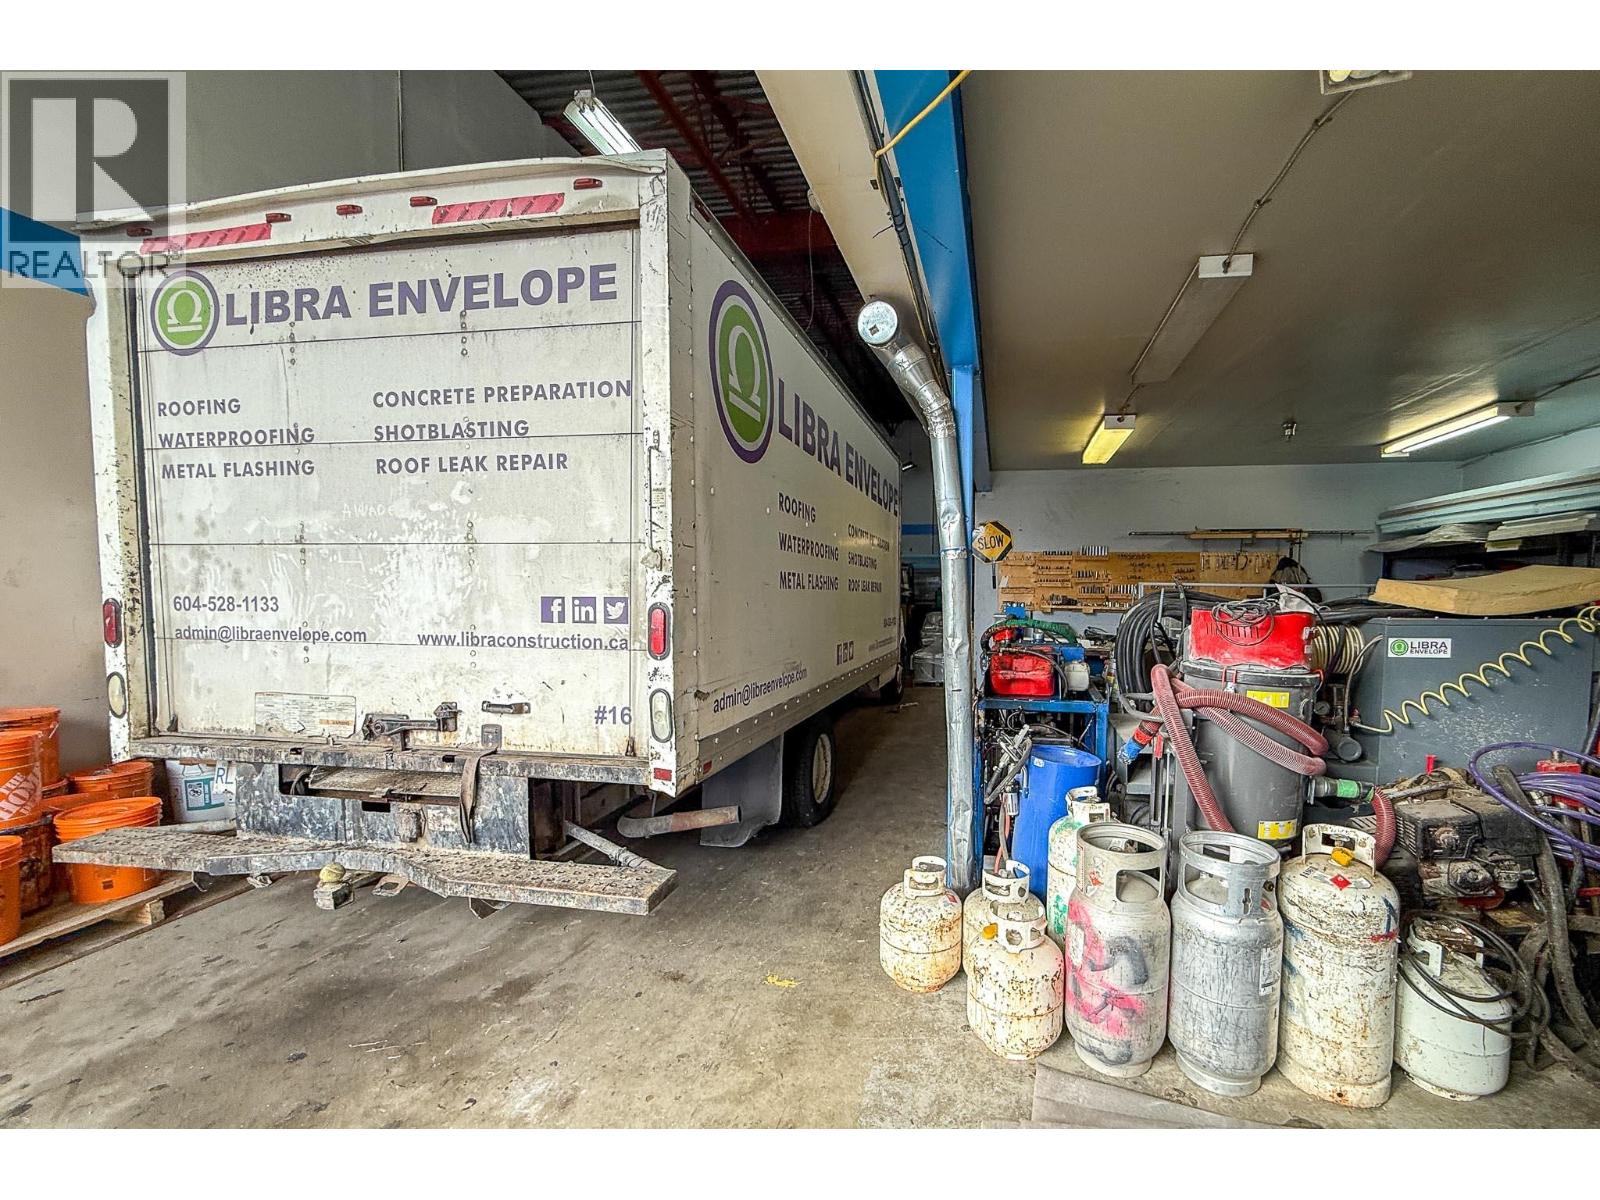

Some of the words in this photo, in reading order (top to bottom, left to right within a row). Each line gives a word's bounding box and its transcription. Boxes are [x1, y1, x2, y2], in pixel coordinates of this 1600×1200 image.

[226, 285, 352, 326] LIBRA
[369, 263, 617, 317] ENVELOPE
[373, 388, 475, 407] CONCRETE
[484, 380, 631, 403] PREPARATION
[157, 399, 241, 416] ROOFING
[159, 427, 315, 448] WATERPROOFING
[374, 420, 529, 441] SHOTBLASTING
[779, 378, 841, 476] LIBRA
[846, 441, 898, 517] ENVELOPE
[162, 463, 216, 479] METAL
[223, 460, 315, 478] FLASHING
[376, 457, 430, 474] ROOF
[438, 455, 488, 473] LEAK
[496, 453, 568, 471] REPAIR
[779, 492, 816, 523] ROOFING
[779, 532, 839, 561] WATERPROOFING
[977, 534, 1004, 550] SLOW
[780, 571, 805, 590] METAL
[808, 573, 838, 591] FLASHING
[173, 596, 279, 612] 604-528-1133
[175, 626, 367, 644] admin@libraenvelope.com
[418, 632, 629, 650] www.libraconstruction.ca
[1410, 641, 1448, 649] LIBRA
[713, 668, 807, 713] admin@libraenvelope.com
[594, 706, 632, 725] #16
